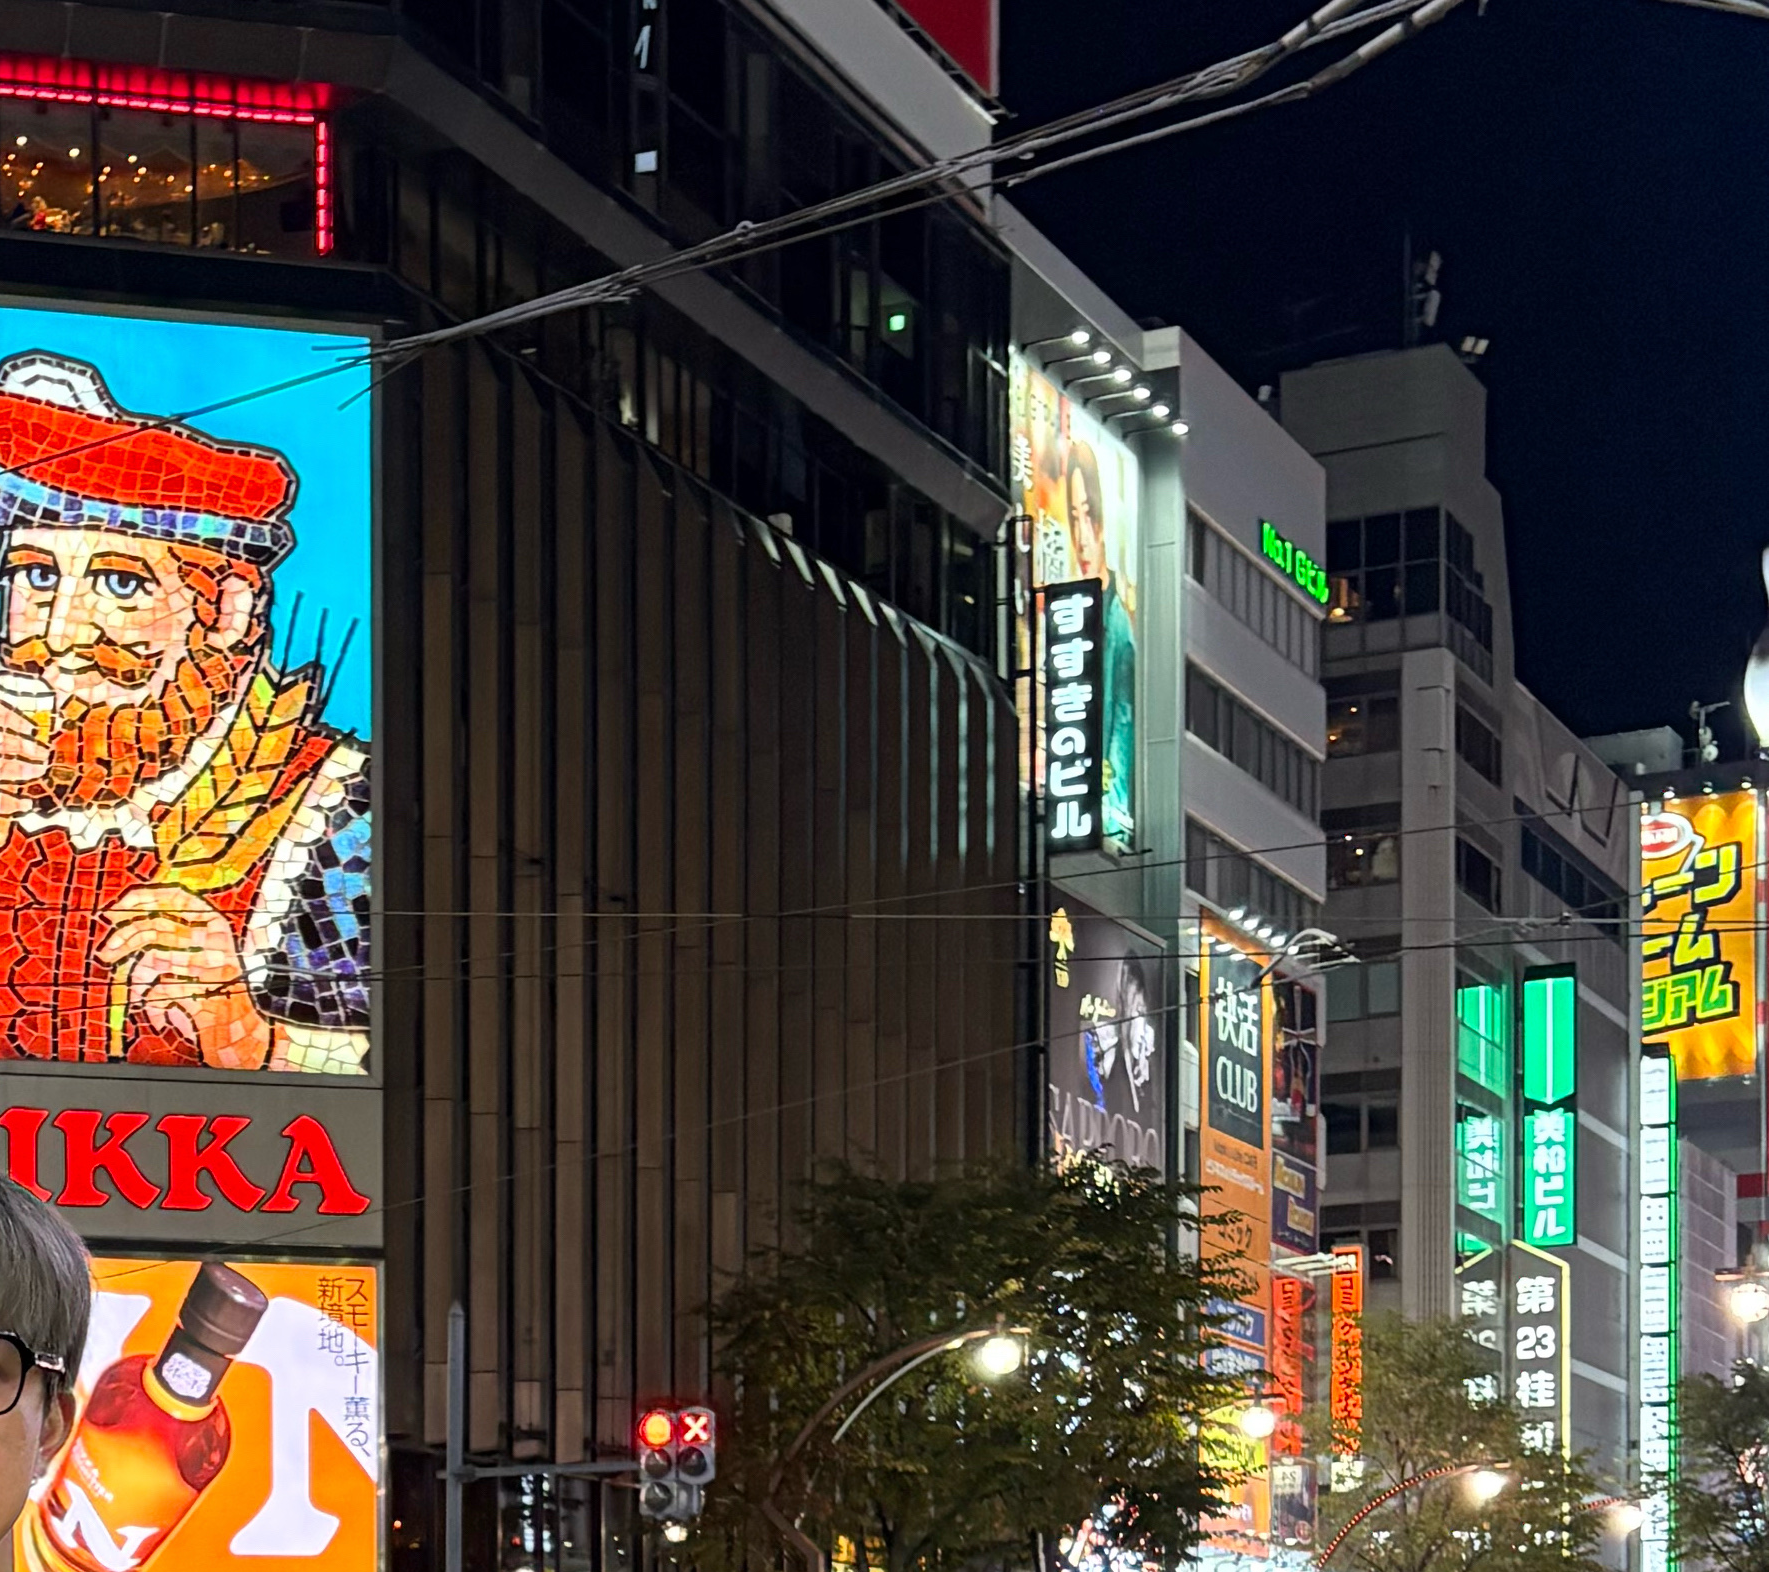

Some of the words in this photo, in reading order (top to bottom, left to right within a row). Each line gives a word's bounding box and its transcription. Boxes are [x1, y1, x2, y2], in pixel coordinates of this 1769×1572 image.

[1049, 591, 1094, 840] すすきのビル
[1214, 976, 1260, 1057] 快活
[1215, 1055, 1258, 1114] CLUB
[316, 1275, 344, 1369] 新境地。
[342, 1276, 371, 1459] スモーキー薫る、
